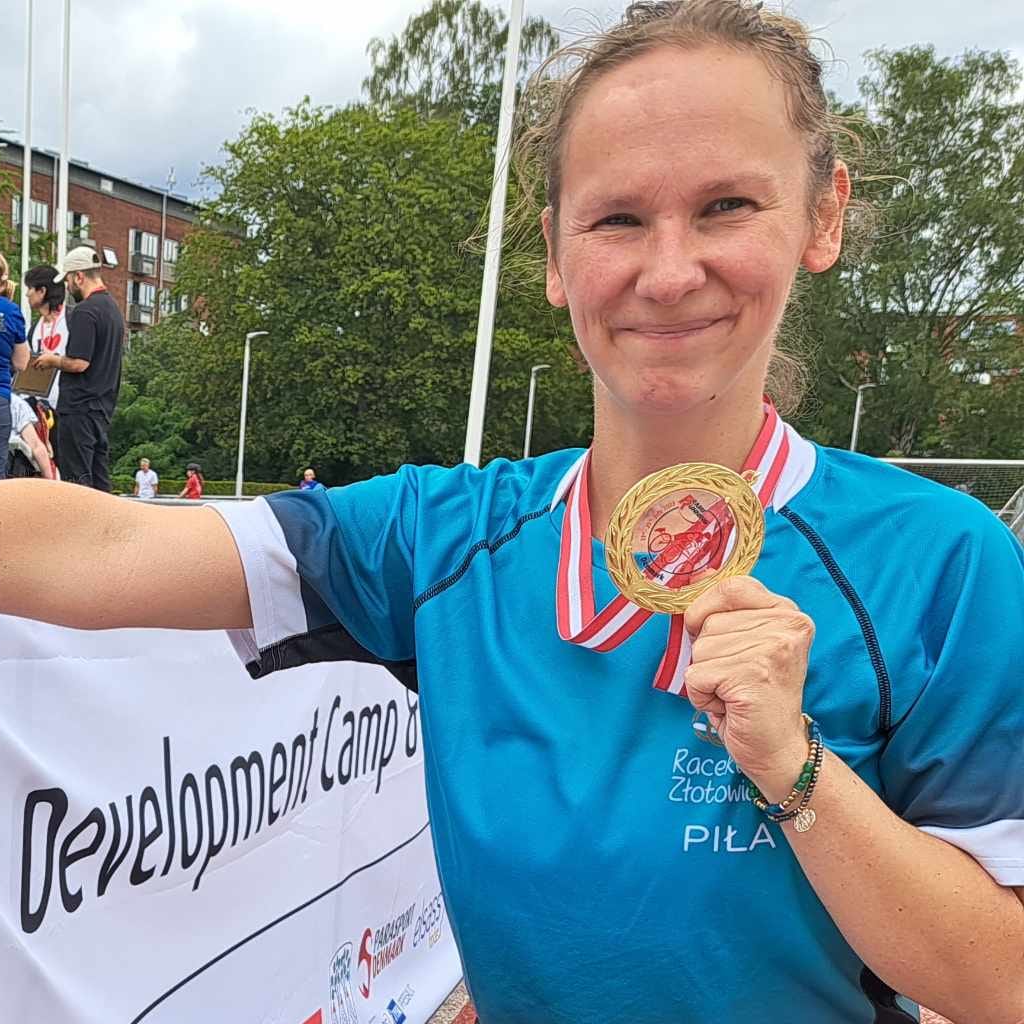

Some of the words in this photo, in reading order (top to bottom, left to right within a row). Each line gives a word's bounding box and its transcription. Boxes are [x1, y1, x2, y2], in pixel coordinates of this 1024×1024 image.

[20, 707, 319, 934] Development
[321, 695, 398, 794] Camp
[683, 822, 776, 852] PIŁA
